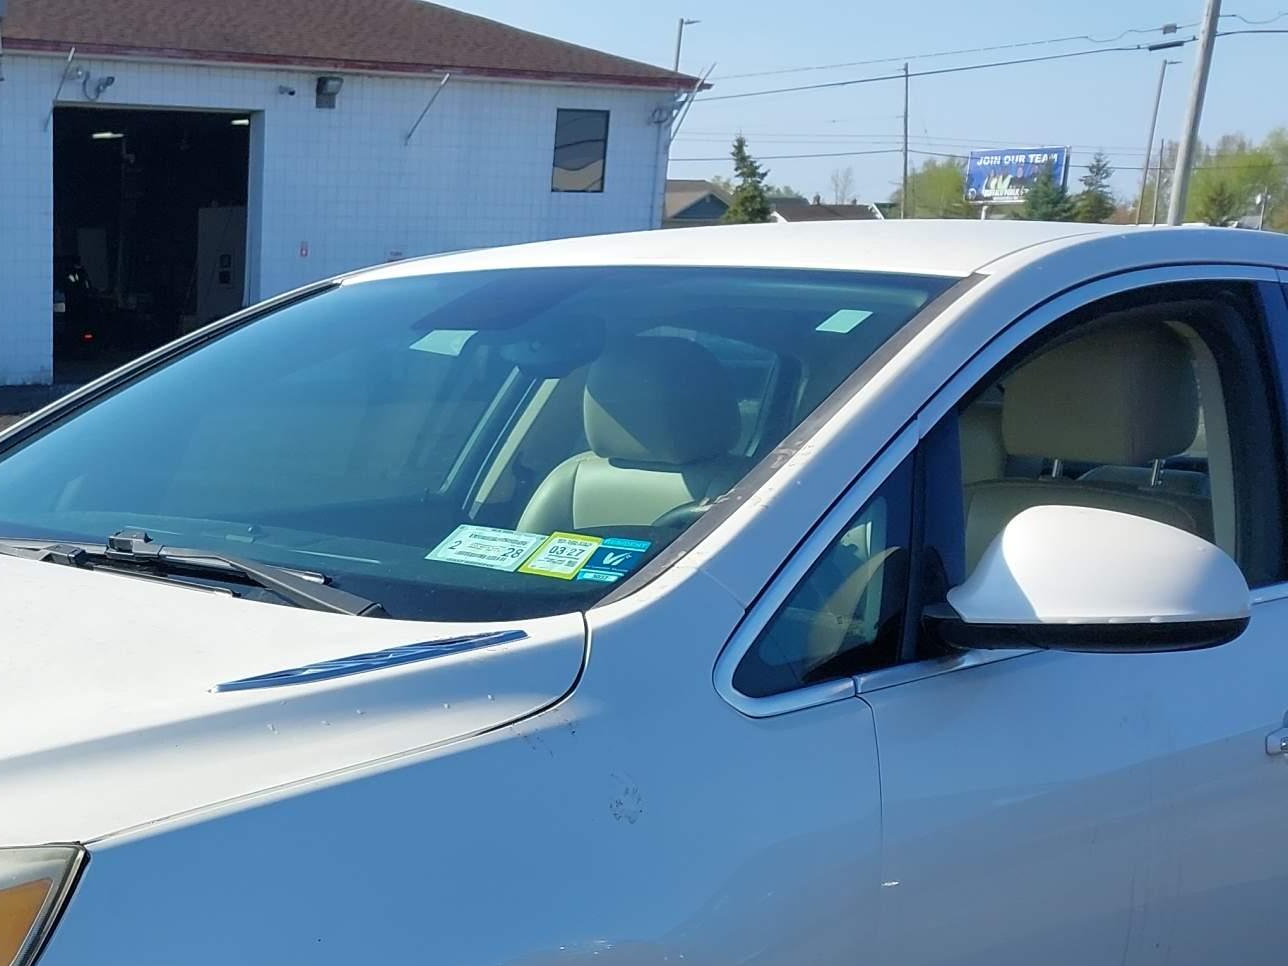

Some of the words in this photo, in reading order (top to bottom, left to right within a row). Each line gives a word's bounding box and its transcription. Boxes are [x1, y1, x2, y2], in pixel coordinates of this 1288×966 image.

[977, 156, 1001, 165] JOIN
[1004, 154, 1026, 164] OUR
[448, 541, 462, 550] 2
[501, 547, 524, 559] 28
